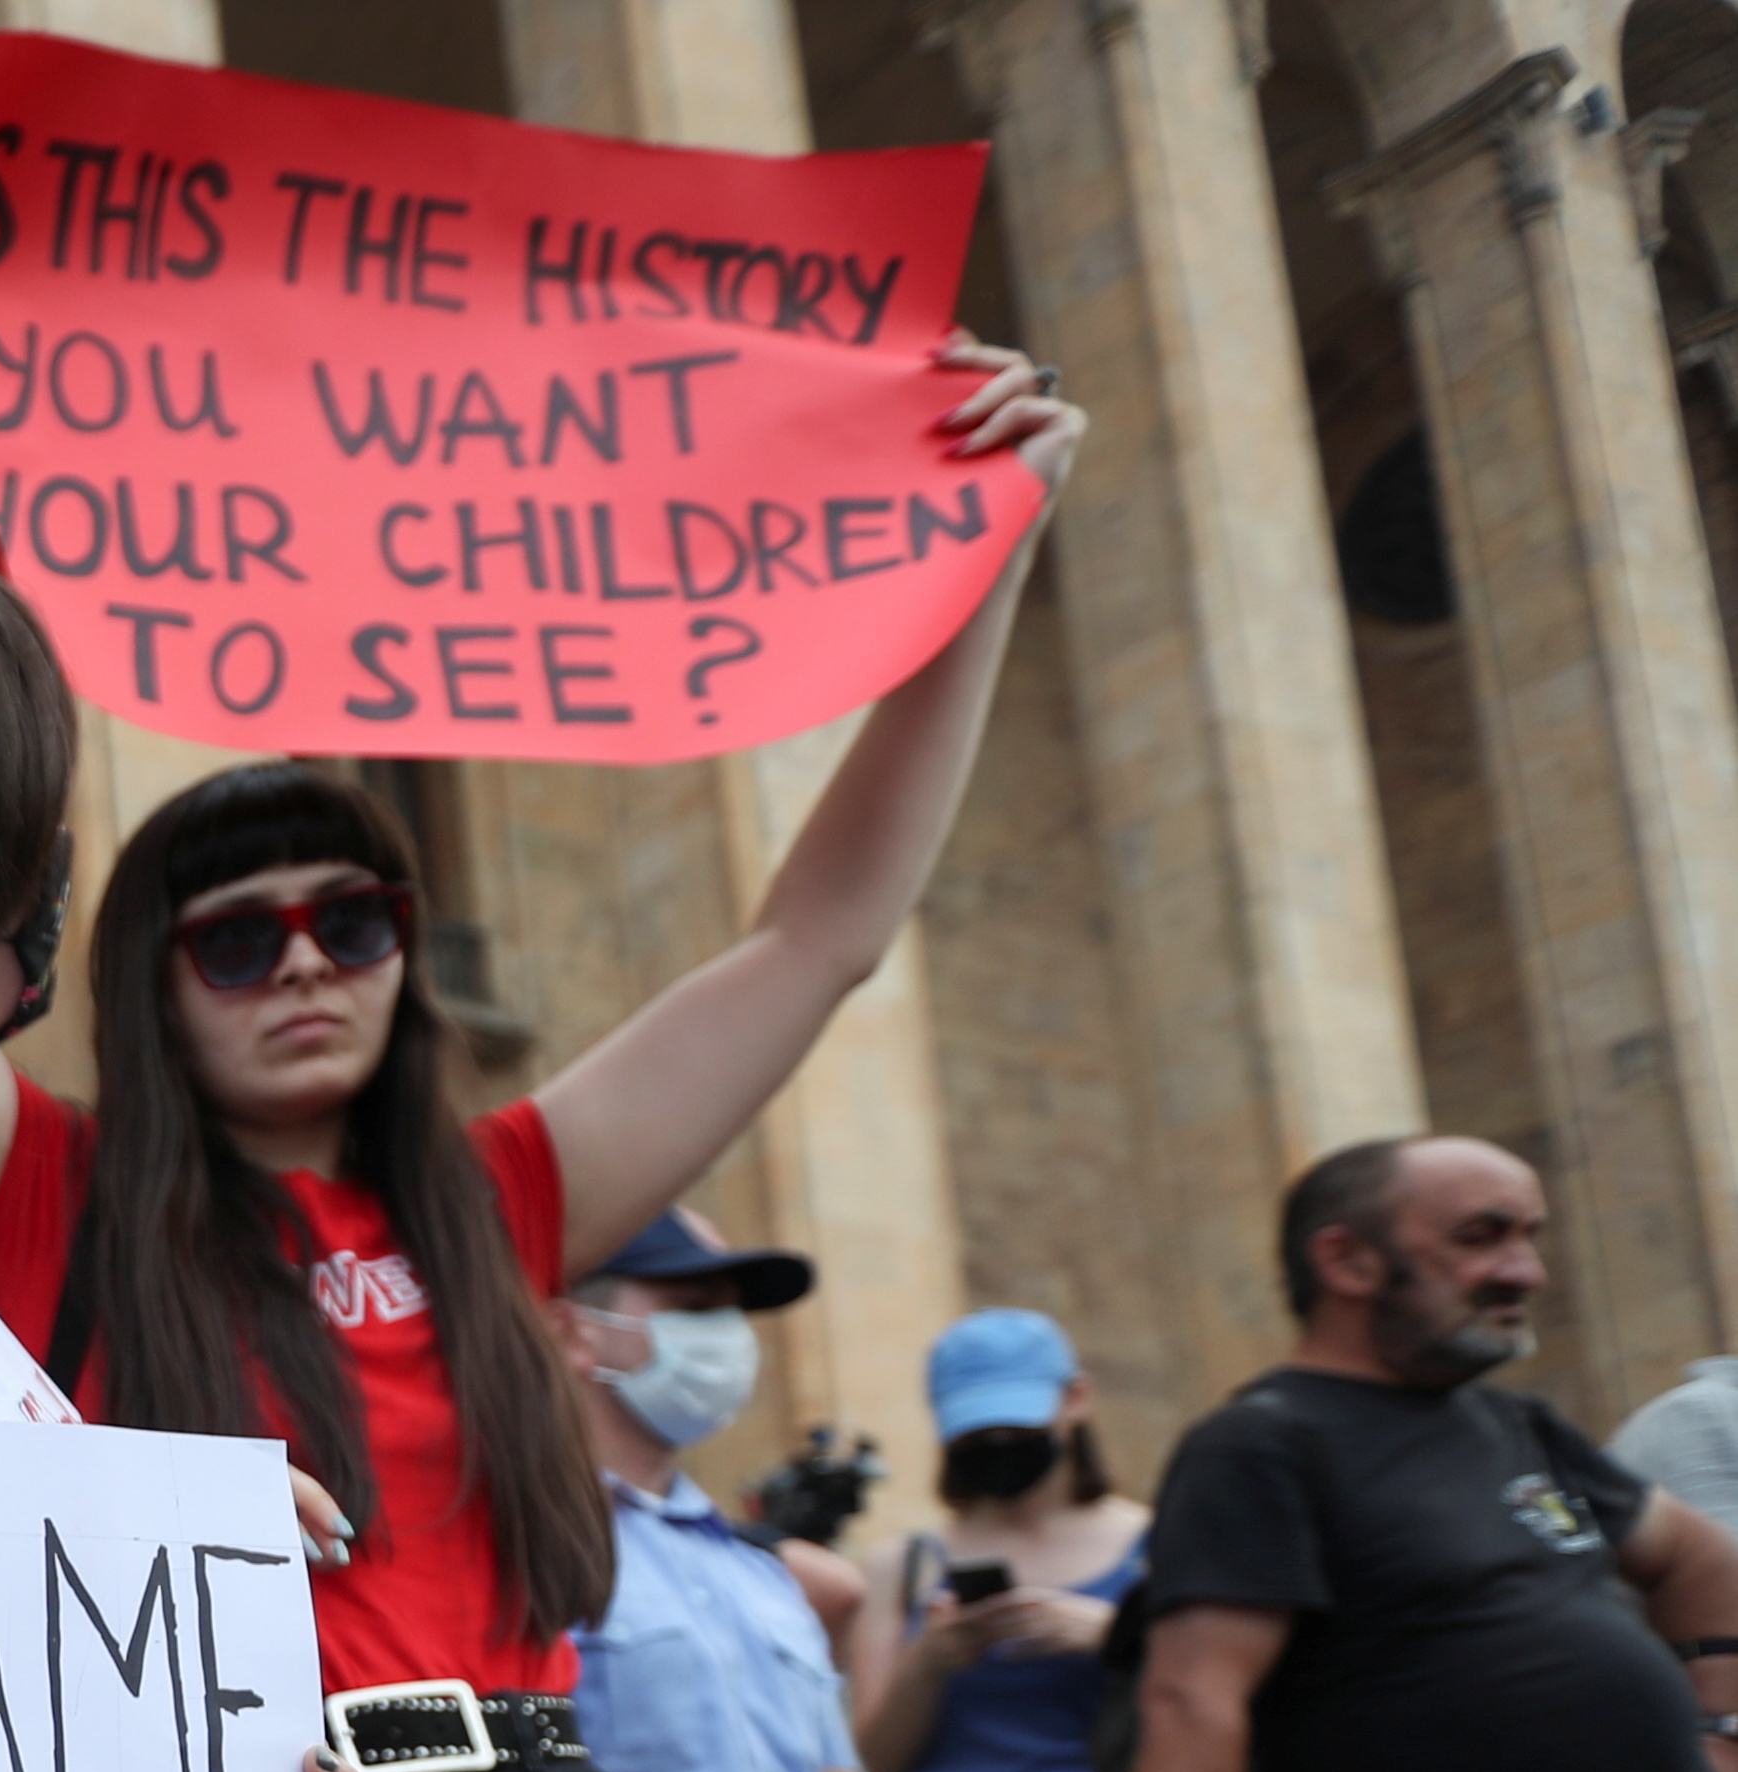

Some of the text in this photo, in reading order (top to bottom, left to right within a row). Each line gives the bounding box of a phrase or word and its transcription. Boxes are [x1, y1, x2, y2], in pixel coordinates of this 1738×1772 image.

[47, 140, 229, 278] THIS
[277, 173, 467, 309] THE
[527, 217, 902, 344] HISTORY
[314, 352, 738, 468] WANT
[379, 482, 990, 602] CHILDREN
[108, 606, 286, 716] TO
